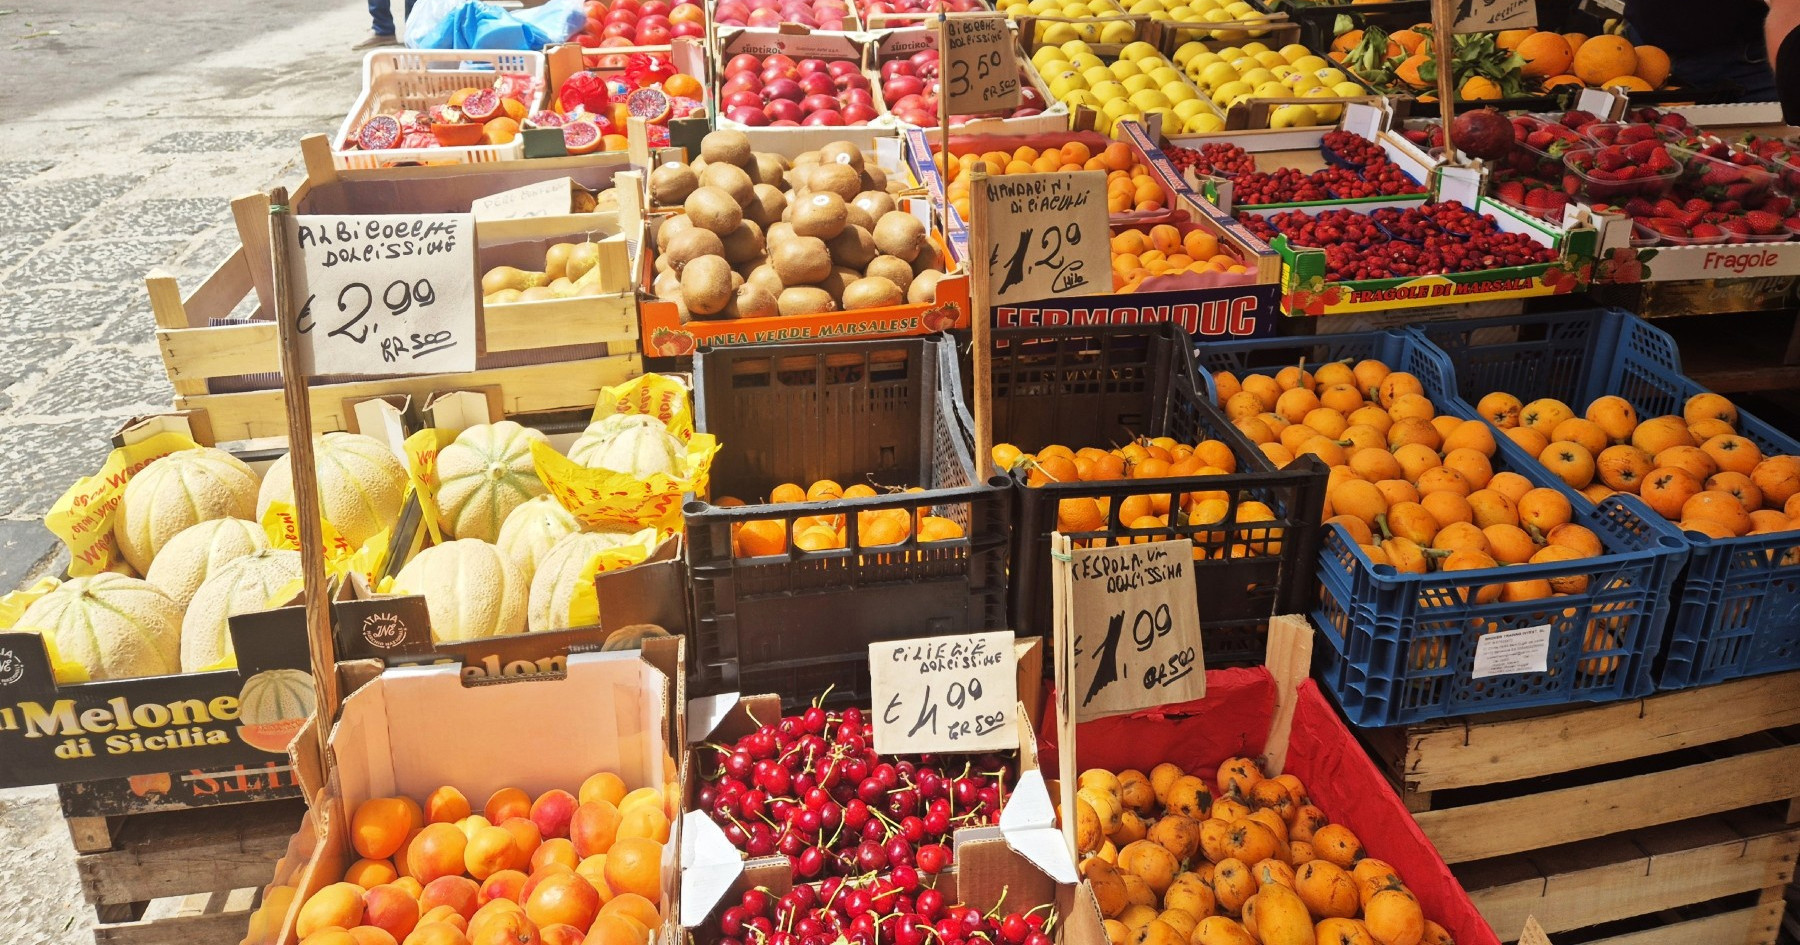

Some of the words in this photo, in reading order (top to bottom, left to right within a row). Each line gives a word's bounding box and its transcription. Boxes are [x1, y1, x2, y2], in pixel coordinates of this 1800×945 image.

[1703, 250, 1779, 273] Fragole
[1349, 285, 1430, 304] FRAGOLE
[1431, 283, 1452, 298] DI
[1453, 277, 1534, 296] MARSALA
[296, 294, 316, 334] €
[411, 330, 453, 351] 500
[696, 332, 749, 348] LINEA
[755, 326, 811, 343] VERDE
[818, 317, 919, 338] MARSALESE
[363, 612, 398, 625] ITALIA
[461, 653, 568, 677] elon
[1168, 646, 1196, 671] 500
[16, 695, 242, 739] Melone
[975, 711, 1005, 734] 500
[54, 737, 96, 760] di
[105, 726, 231, 755] Sicilia
